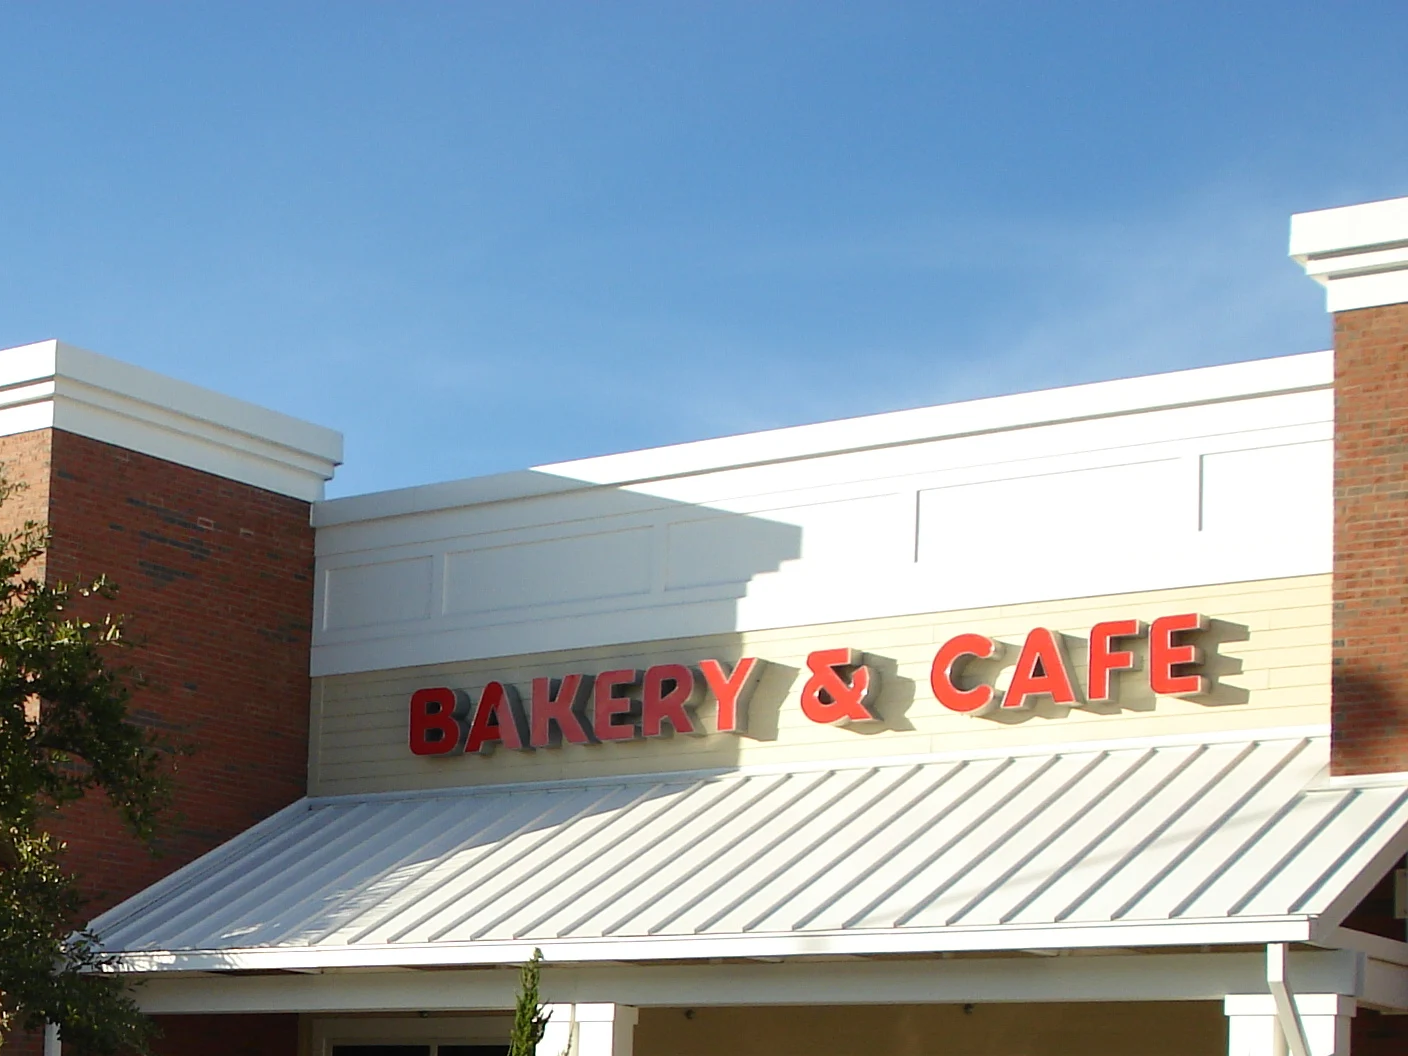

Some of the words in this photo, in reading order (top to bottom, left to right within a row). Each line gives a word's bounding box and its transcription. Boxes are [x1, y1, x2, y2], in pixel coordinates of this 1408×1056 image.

[407, 657, 759, 758] BAKERY
[800, 648, 884, 726] &
[929, 612, 1207, 716] CAFE
